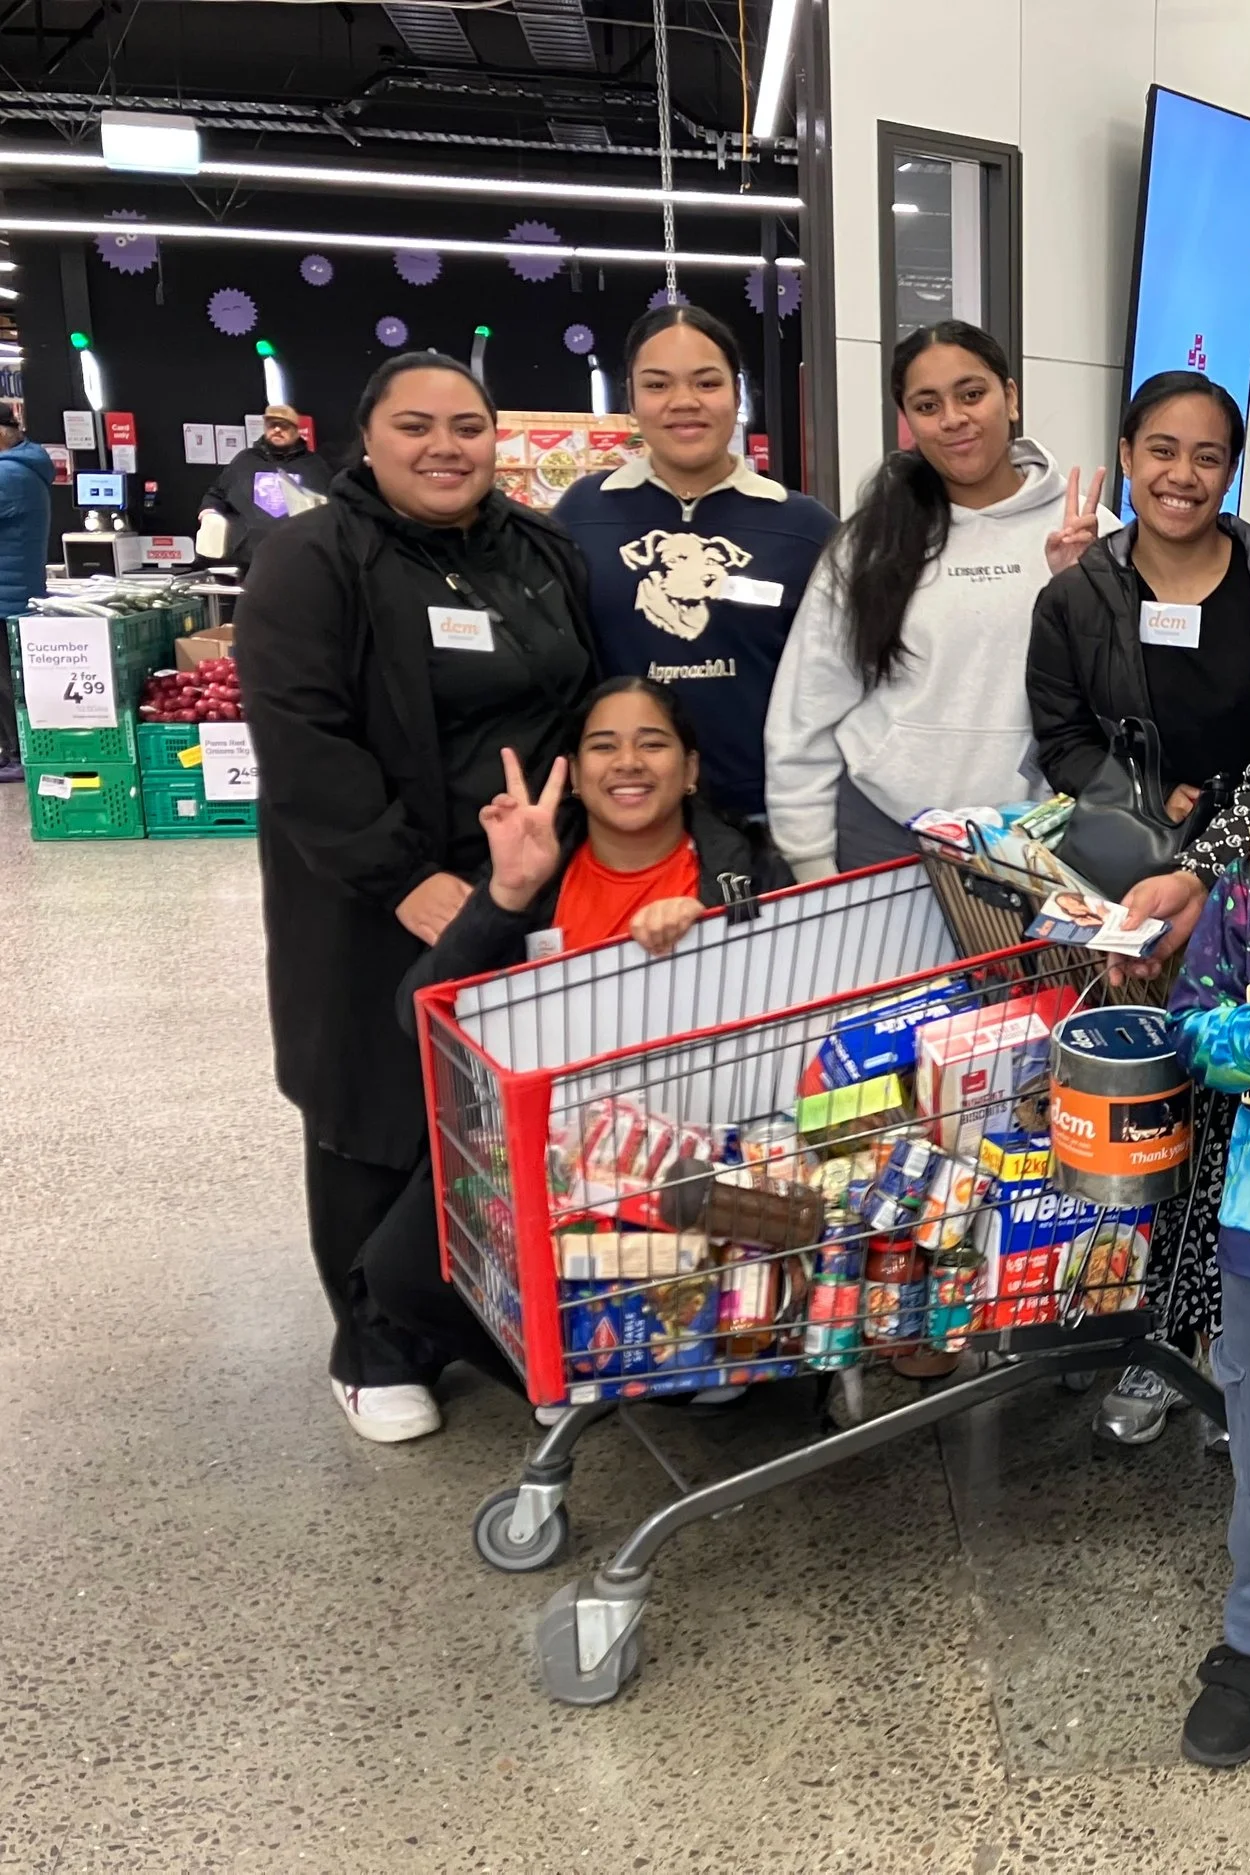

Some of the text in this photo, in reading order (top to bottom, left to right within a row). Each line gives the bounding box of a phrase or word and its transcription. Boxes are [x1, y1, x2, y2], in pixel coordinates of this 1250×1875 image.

[947, 563, 1021, 577] LEISURE CLUB
[440, 616, 481, 636] dcm
[1148, 610, 1187, 631] dcm
[27, 641, 89, 653] Cucumber
[28, 653, 89, 666] Telegraph
[70, 671, 98, 681] 2 for
[1051, 1097, 1097, 1140] dcm
[1130, 1146, 1168, 1165] Thank
[623, 1312, 636, 1369] VEGTABLE
